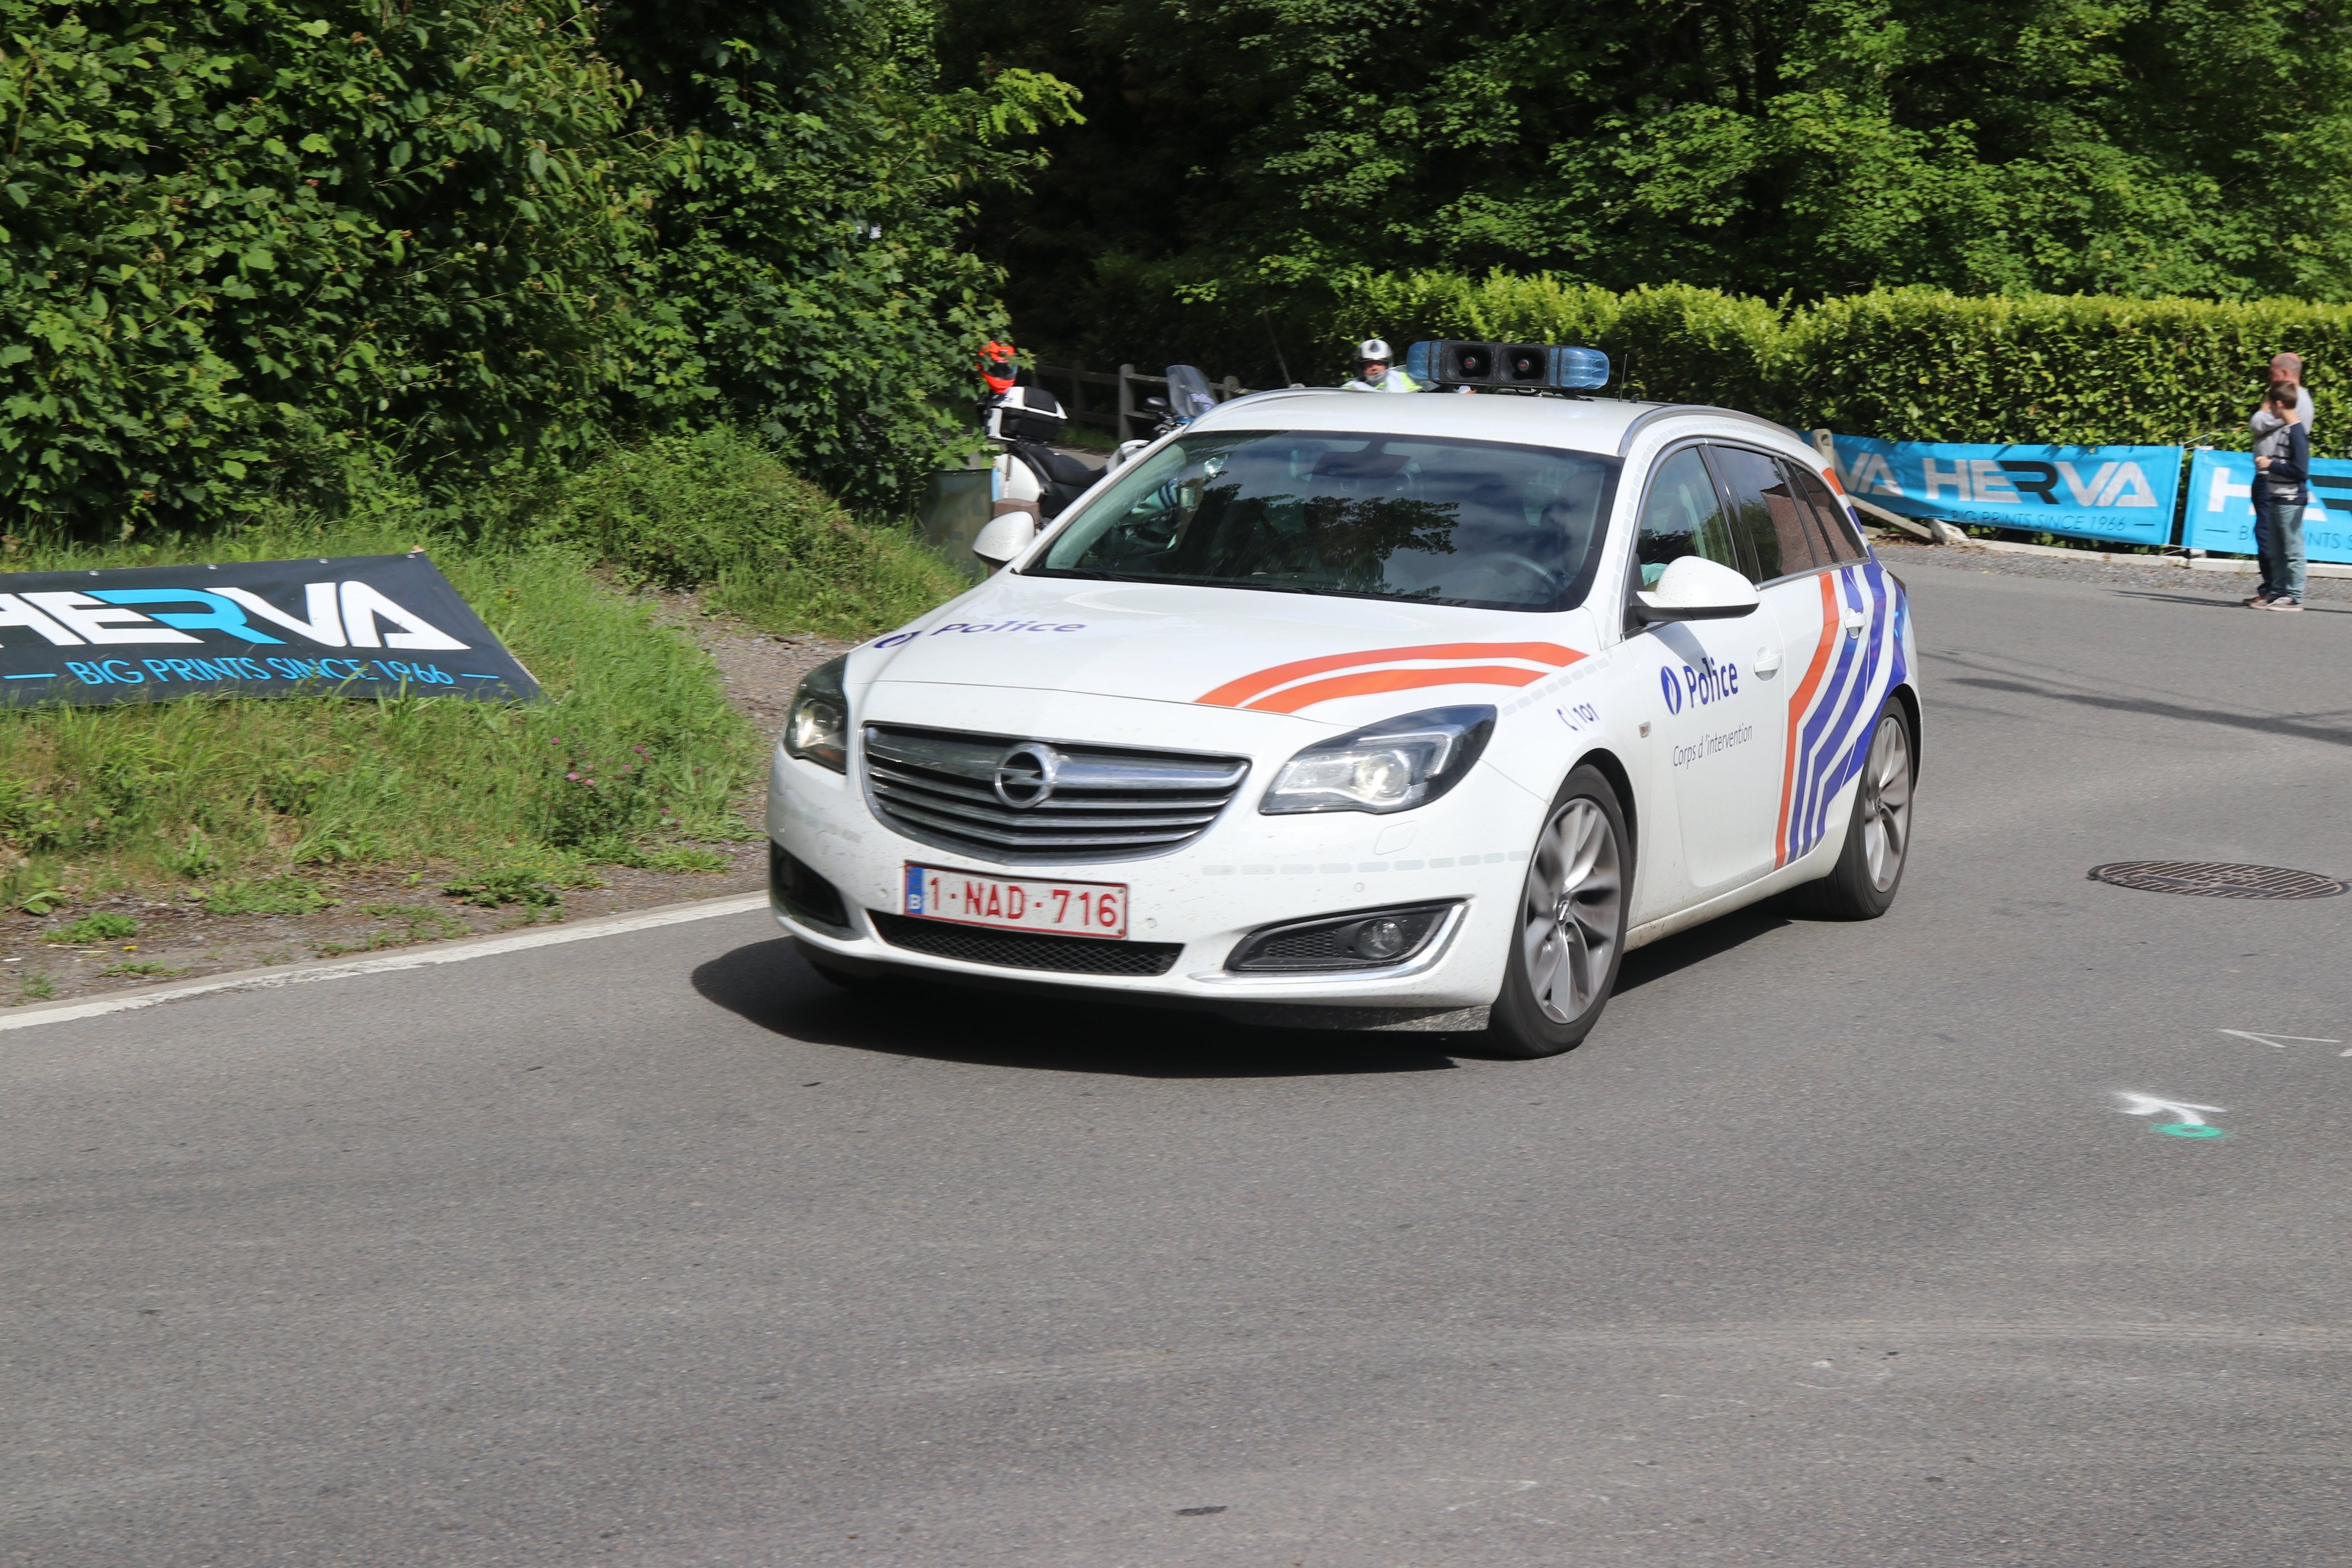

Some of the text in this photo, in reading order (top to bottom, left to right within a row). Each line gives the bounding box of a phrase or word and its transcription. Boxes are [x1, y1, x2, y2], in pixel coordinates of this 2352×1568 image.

[1923, 457, 2159, 507] HERVA
[2035, 513, 2086, 530] SINCE
[2088, 516, 2126, 531] 1966
[929, 620, 1087, 636] Police
[64, 656, 454, 685] BIG PRINTS SINCE 1966
[1683, 656, 1739, 708] Police
[1673, 746, 1696, 769] Corps
[907, 893, 923, 910] B
